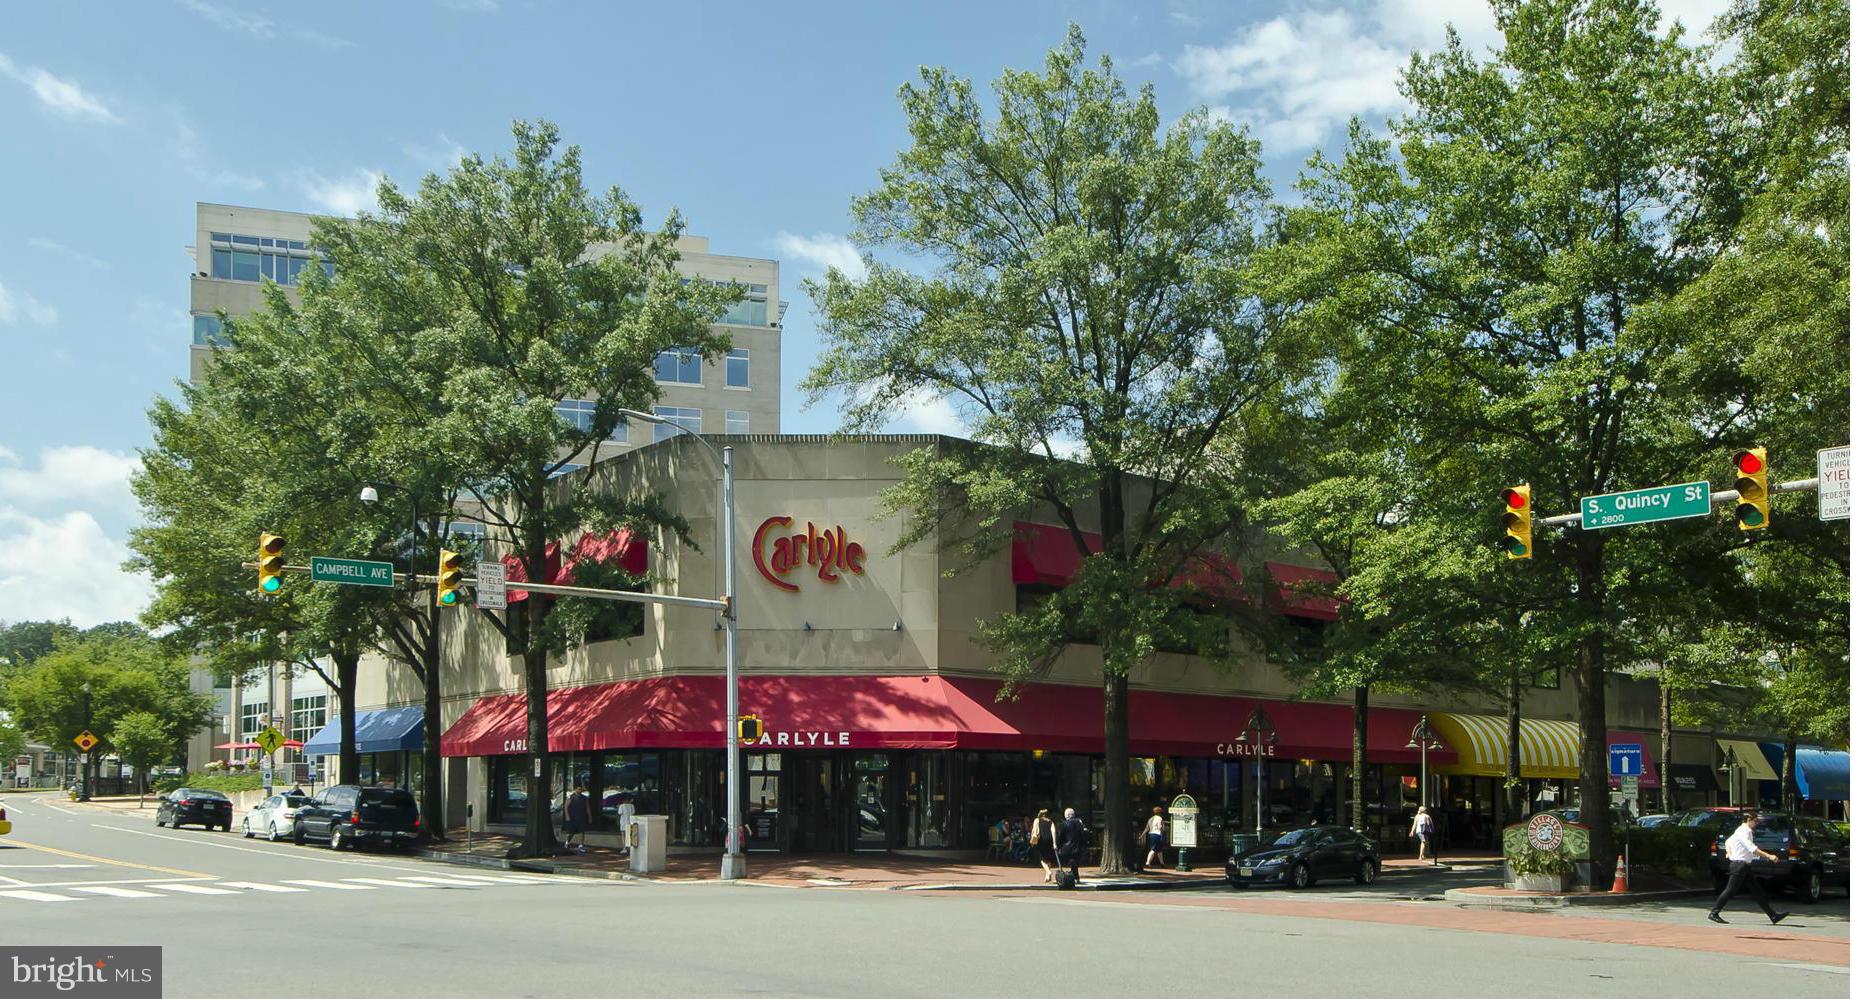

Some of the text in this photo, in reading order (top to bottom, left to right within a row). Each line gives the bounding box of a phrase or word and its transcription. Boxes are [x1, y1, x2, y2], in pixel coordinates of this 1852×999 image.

[1827, 450, 1850, 459] TURNI
[1588, 486, 1703, 514] S. Quincy St
[1601, 514, 1625, 524] 2800
[752, 516, 865, 592] Carlyle
[316, 563, 388, 579] CAMPBELL AVE
[480, 576, 503, 585] YIELD
[504, 739, 528, 751] CARL
[744, 732, 850, 746] ARLYLE
[1217, 743, 1275, 756] CARLYLE
